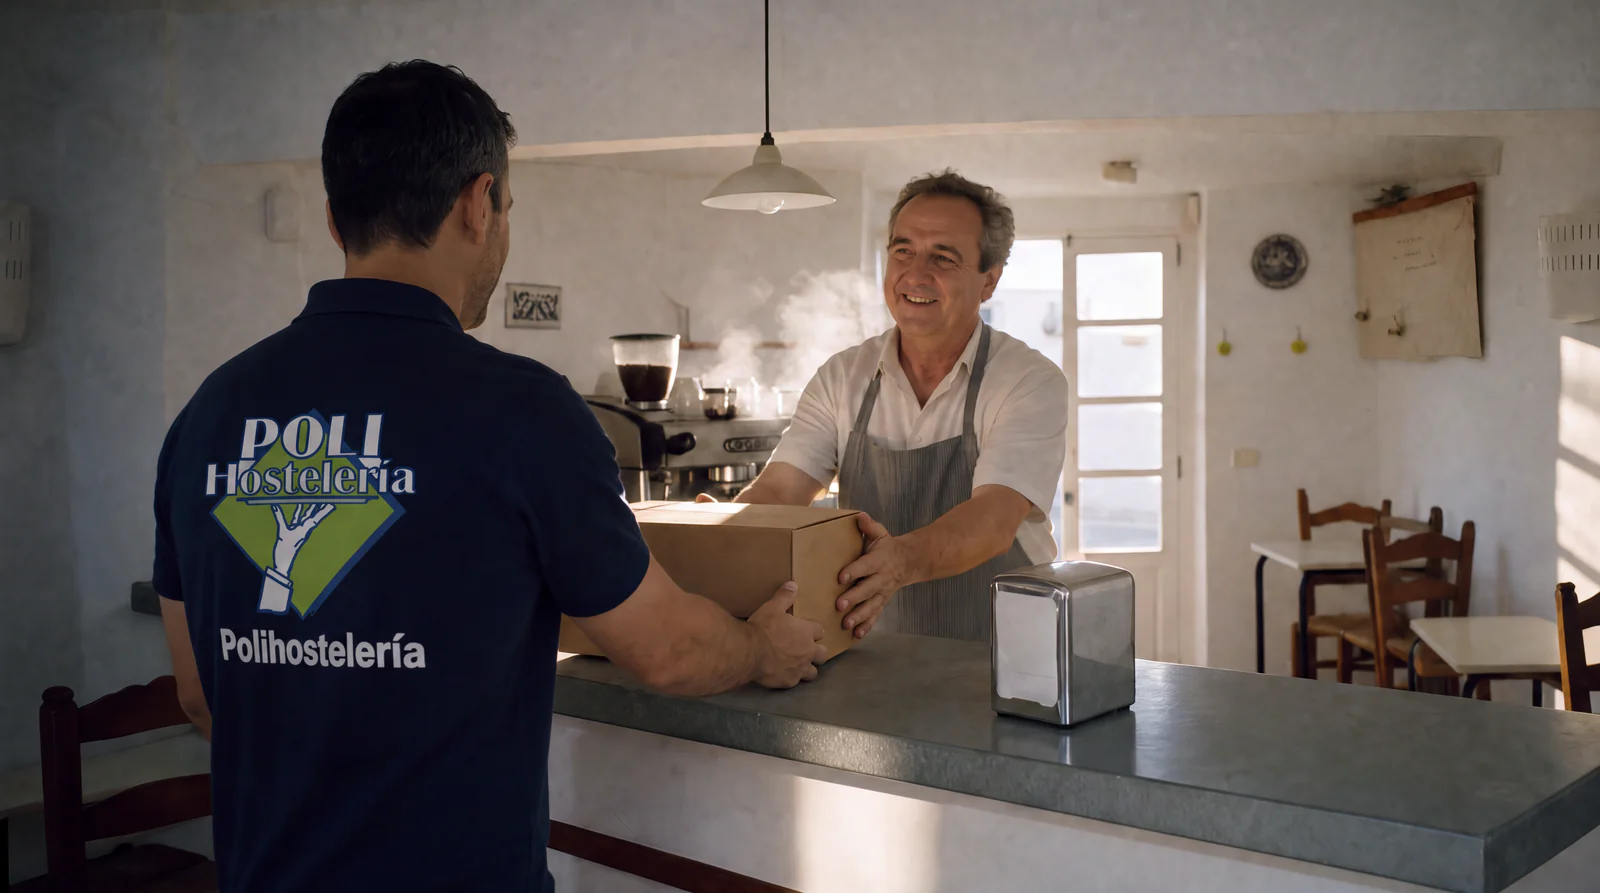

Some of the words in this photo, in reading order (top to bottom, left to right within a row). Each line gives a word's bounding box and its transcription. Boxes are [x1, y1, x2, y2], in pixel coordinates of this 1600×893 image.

[240, 413, 384, 461] POLI
[205, 459, 416, 496] Hostelería
[220, 628, 426, 668] Polihostelería
